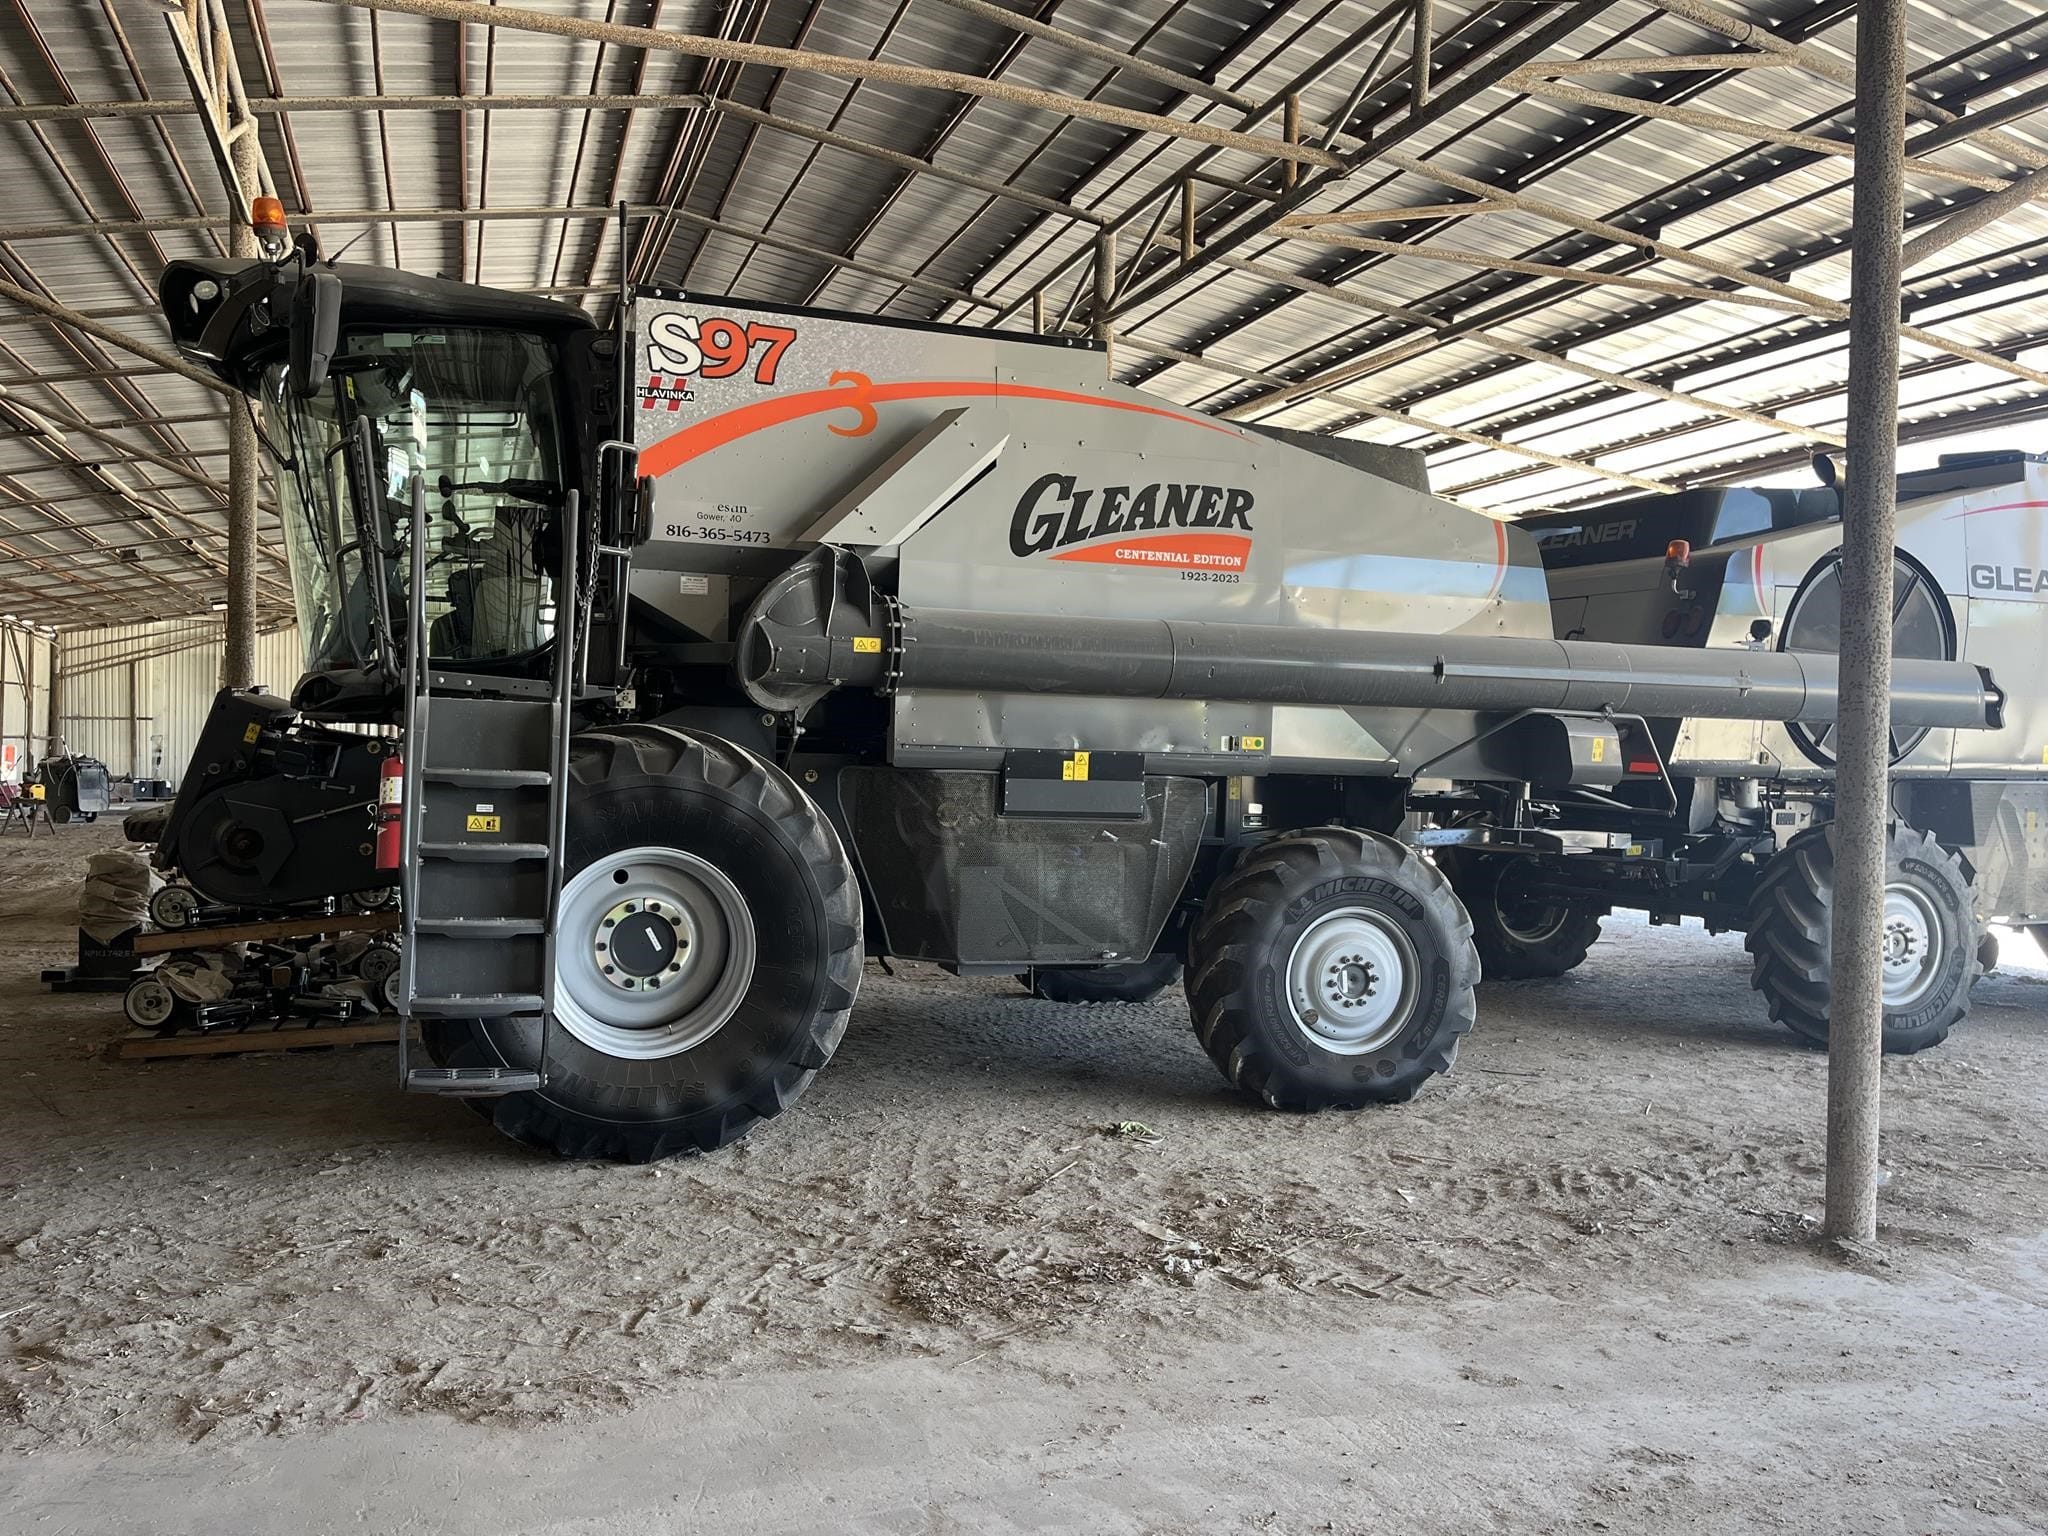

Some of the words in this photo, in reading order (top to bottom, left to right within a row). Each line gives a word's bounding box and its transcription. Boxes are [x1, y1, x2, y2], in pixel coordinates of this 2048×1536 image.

[647, 312, 797, 385] S97
[637, 388, 694, 401] HLAVINKA
[1009, 472, 1255, 558] GLEANER
[666, 524, 771, 544] 816-365-5473
[1115, 548, 1190, 564] CENTENNIAL
[1193, 553, 1241, 567] EDITION
[1180, 571, 1240, 584] 1923-2023
[1314, 877, 1419, 914] MICHELIN
[1893, 978, 1955, 1030] MICHELIN
